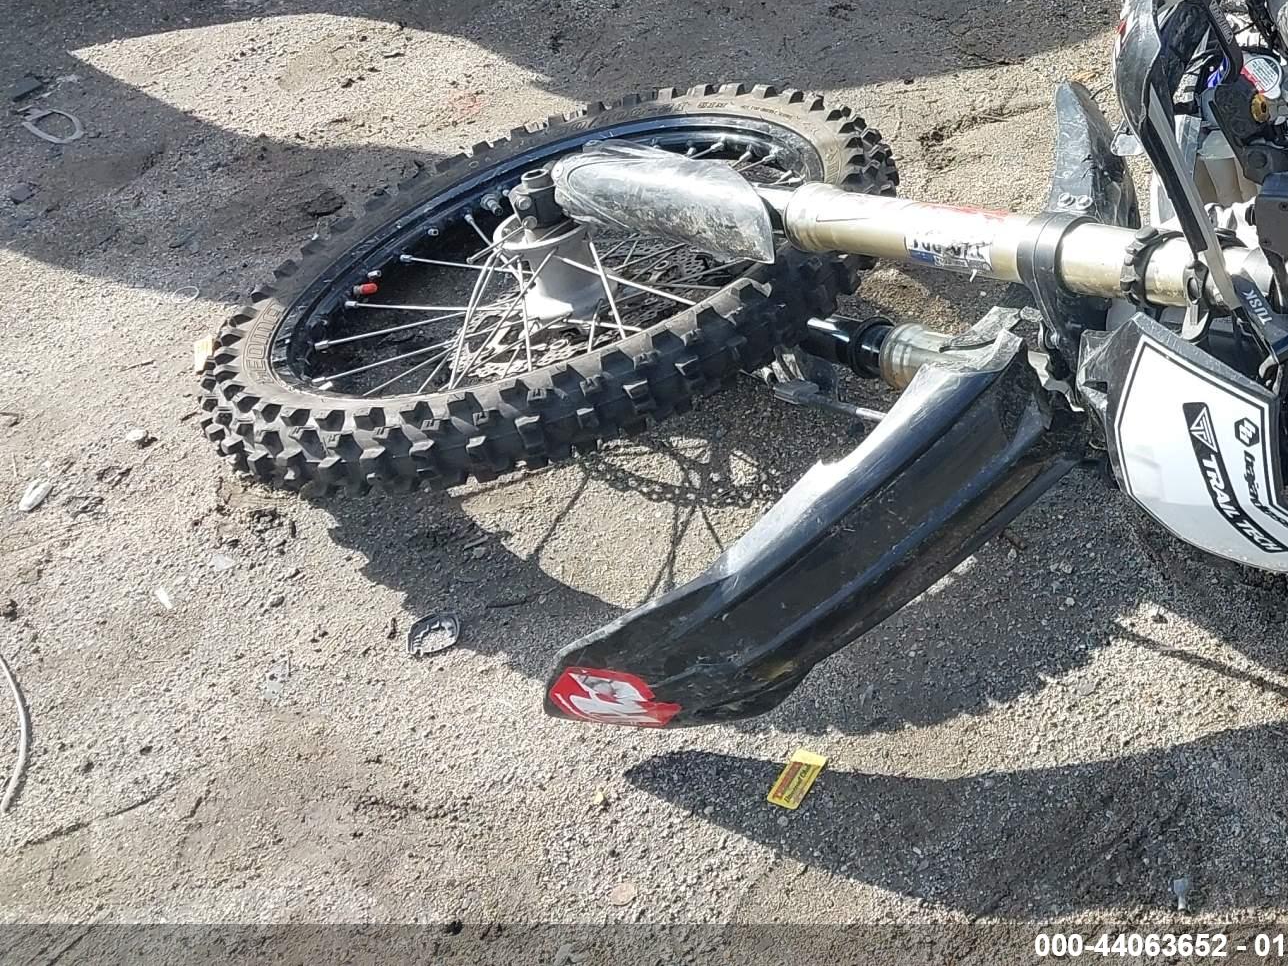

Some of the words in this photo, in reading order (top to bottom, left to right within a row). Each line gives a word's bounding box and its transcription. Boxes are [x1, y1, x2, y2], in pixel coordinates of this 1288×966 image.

[1241, 289, 1273, 325] TUSK
[1202, 453, 1241, 520] TRAIL
[1236, 519, 1285, 552] TECH
